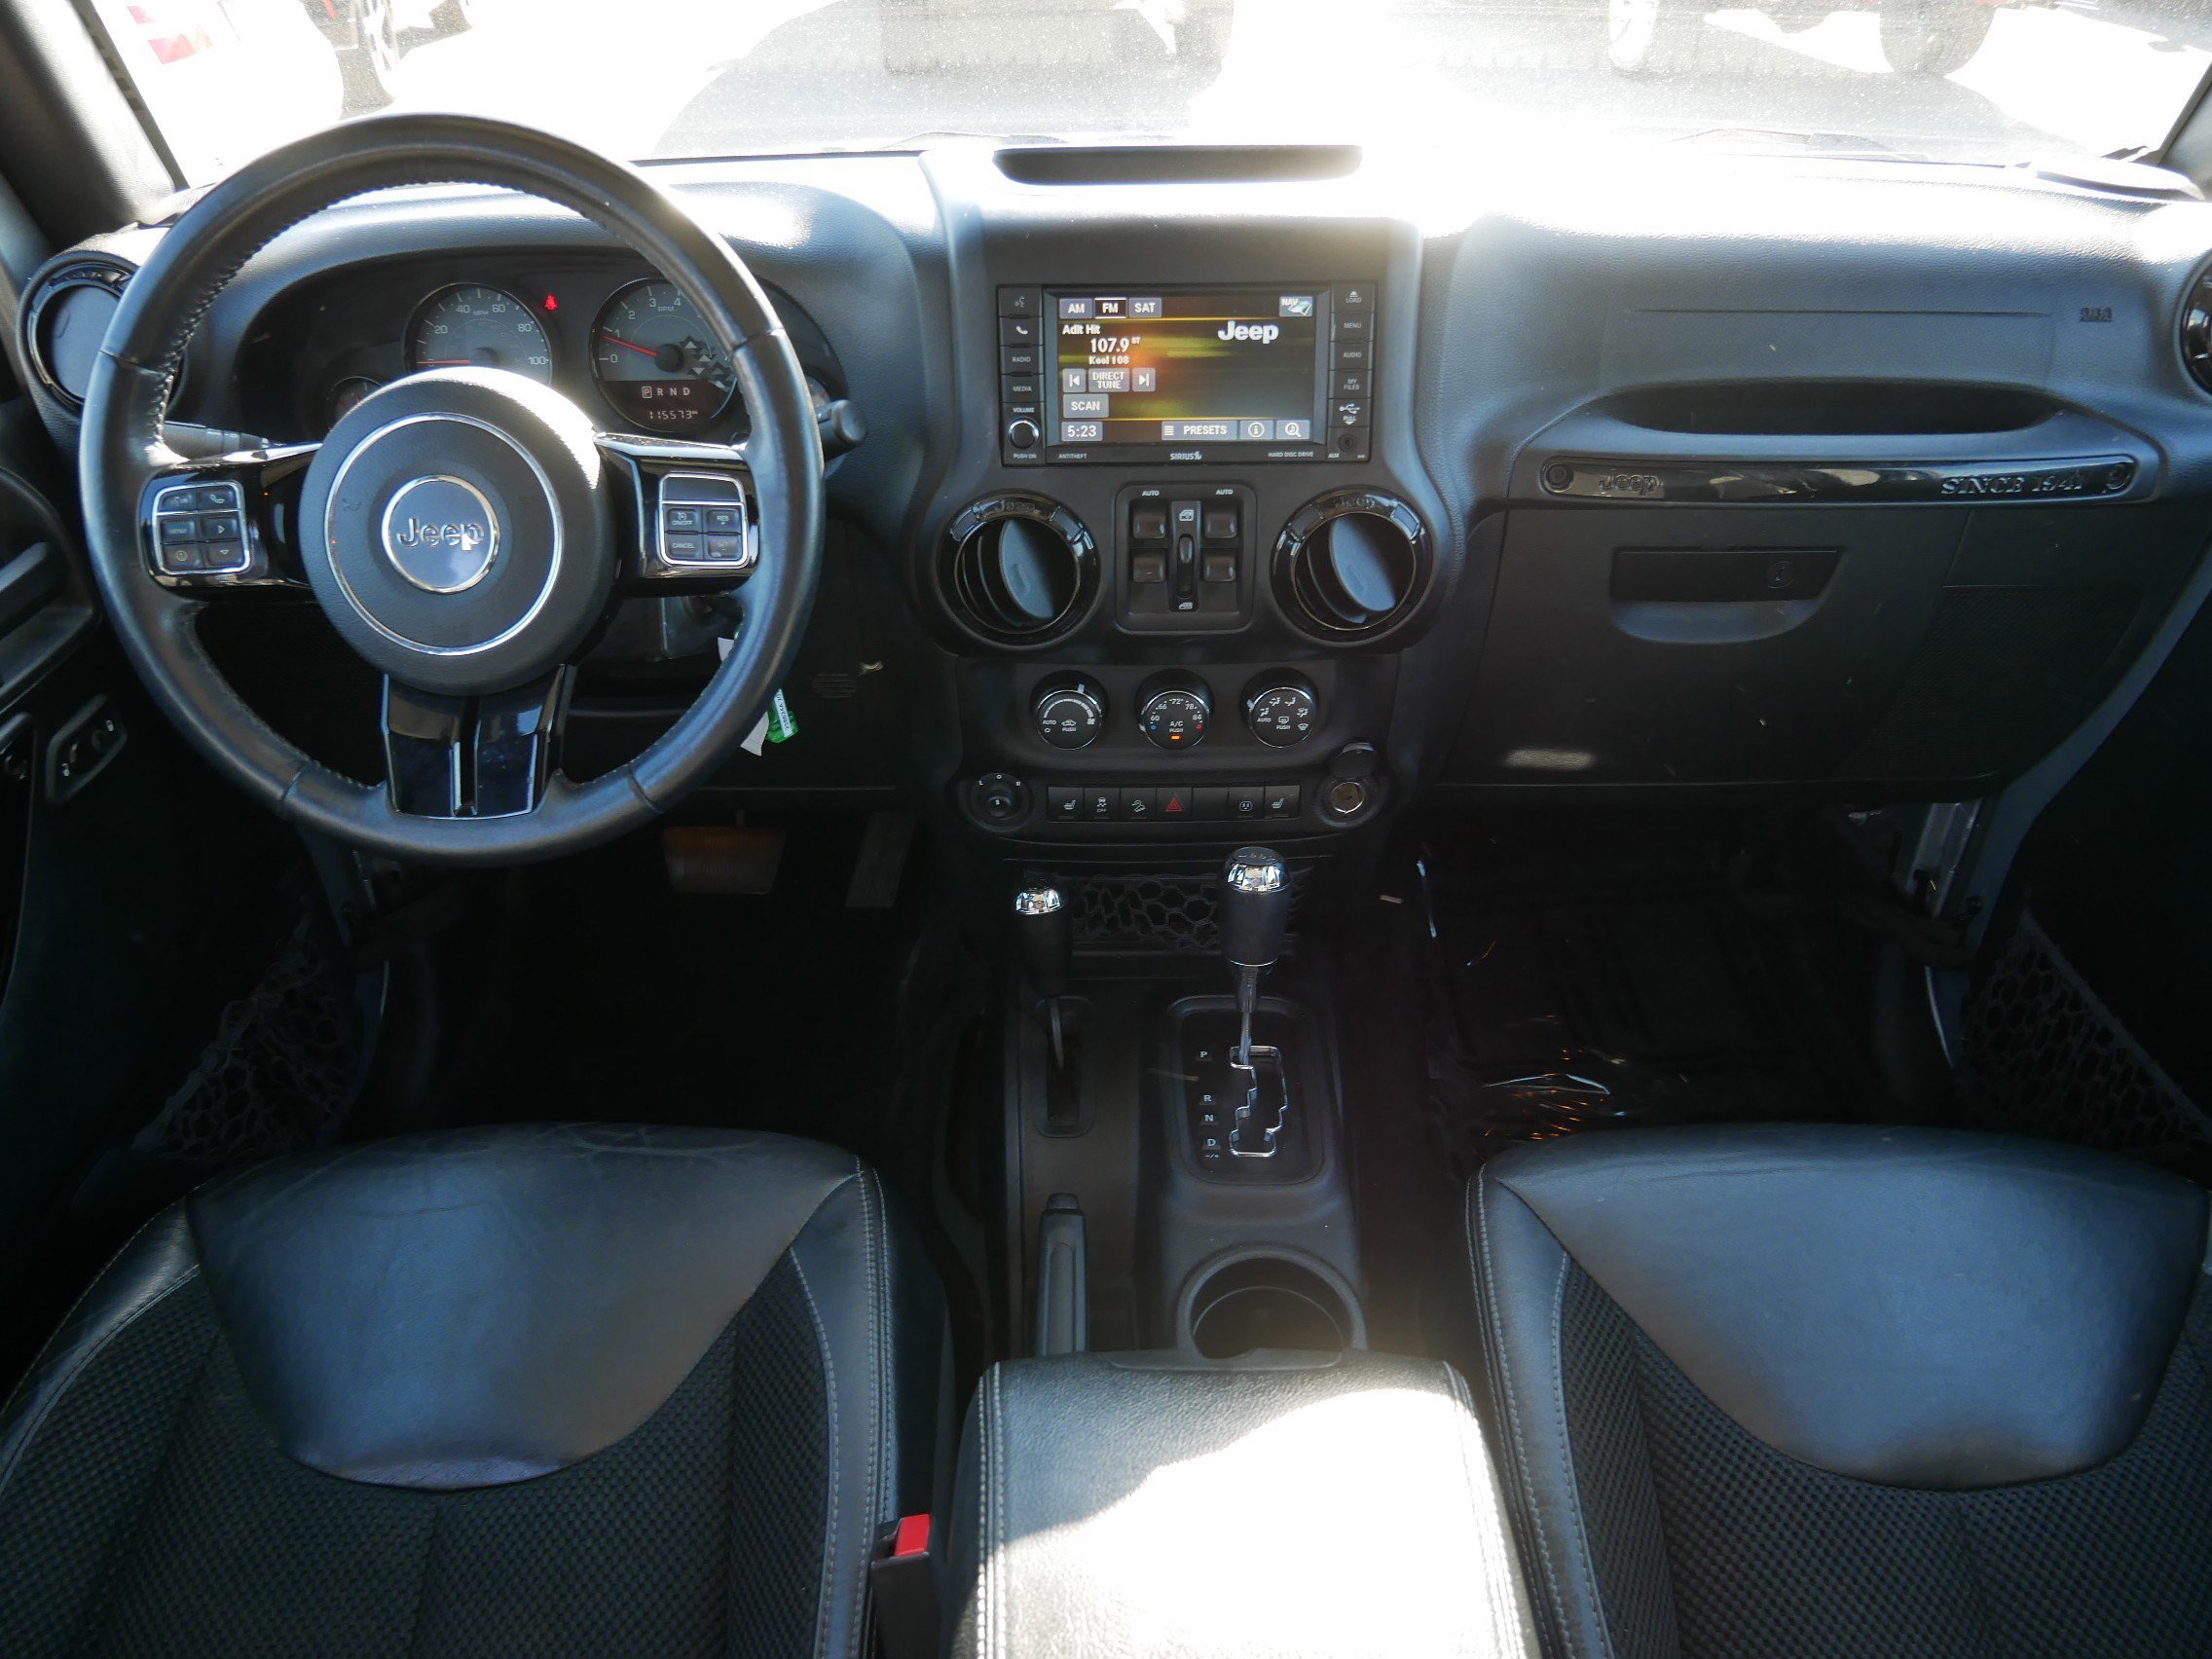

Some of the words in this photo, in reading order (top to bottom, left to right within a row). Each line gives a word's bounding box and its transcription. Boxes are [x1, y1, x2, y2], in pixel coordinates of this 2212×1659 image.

[648, 298, 656, 308] 3
[673, 297, 681, 307] 4
[457, 305, 470, 313] 40
[492, 304, 506, 313] 60
[1068, 303, 1086, 313] AM
[1102, 303, 1119, 313] FM
[1134, 302, 1156, 313] SAT
[628, 311, 636, 320] 2
[434, 324, 448, 334] 20
[517, 323, 532, 332] 80
[1086, 324, 1101, 335] Hit
[1217, 320, 1279, 345] Jeep
[1090, 337, 1129, 353] 107.9
[528, 356, 546, 365] 100
[609, 353, 618, 363] 0
[1088, 355, 1110, 365] Kool
[1112, 355, 1129, 365] 108
[1092, 371, 1125, 381] DIRECT
[1097, 380, 1122, 389] TUNE
[656, 387, 664, 396] R
[670, 387, 678, 396] N
[682, 387, 690, 396] D
[1070, 401, 1101, 411] SCAN
[1067, 425, 1097, 438] 5:23
[1183, 424, 1228, 435] PRESETS
[1940, 476, 2026, 495] SINCE
[396, 517, 485, 552] Jeep
[1207, 1138, 1217, 1147] D
